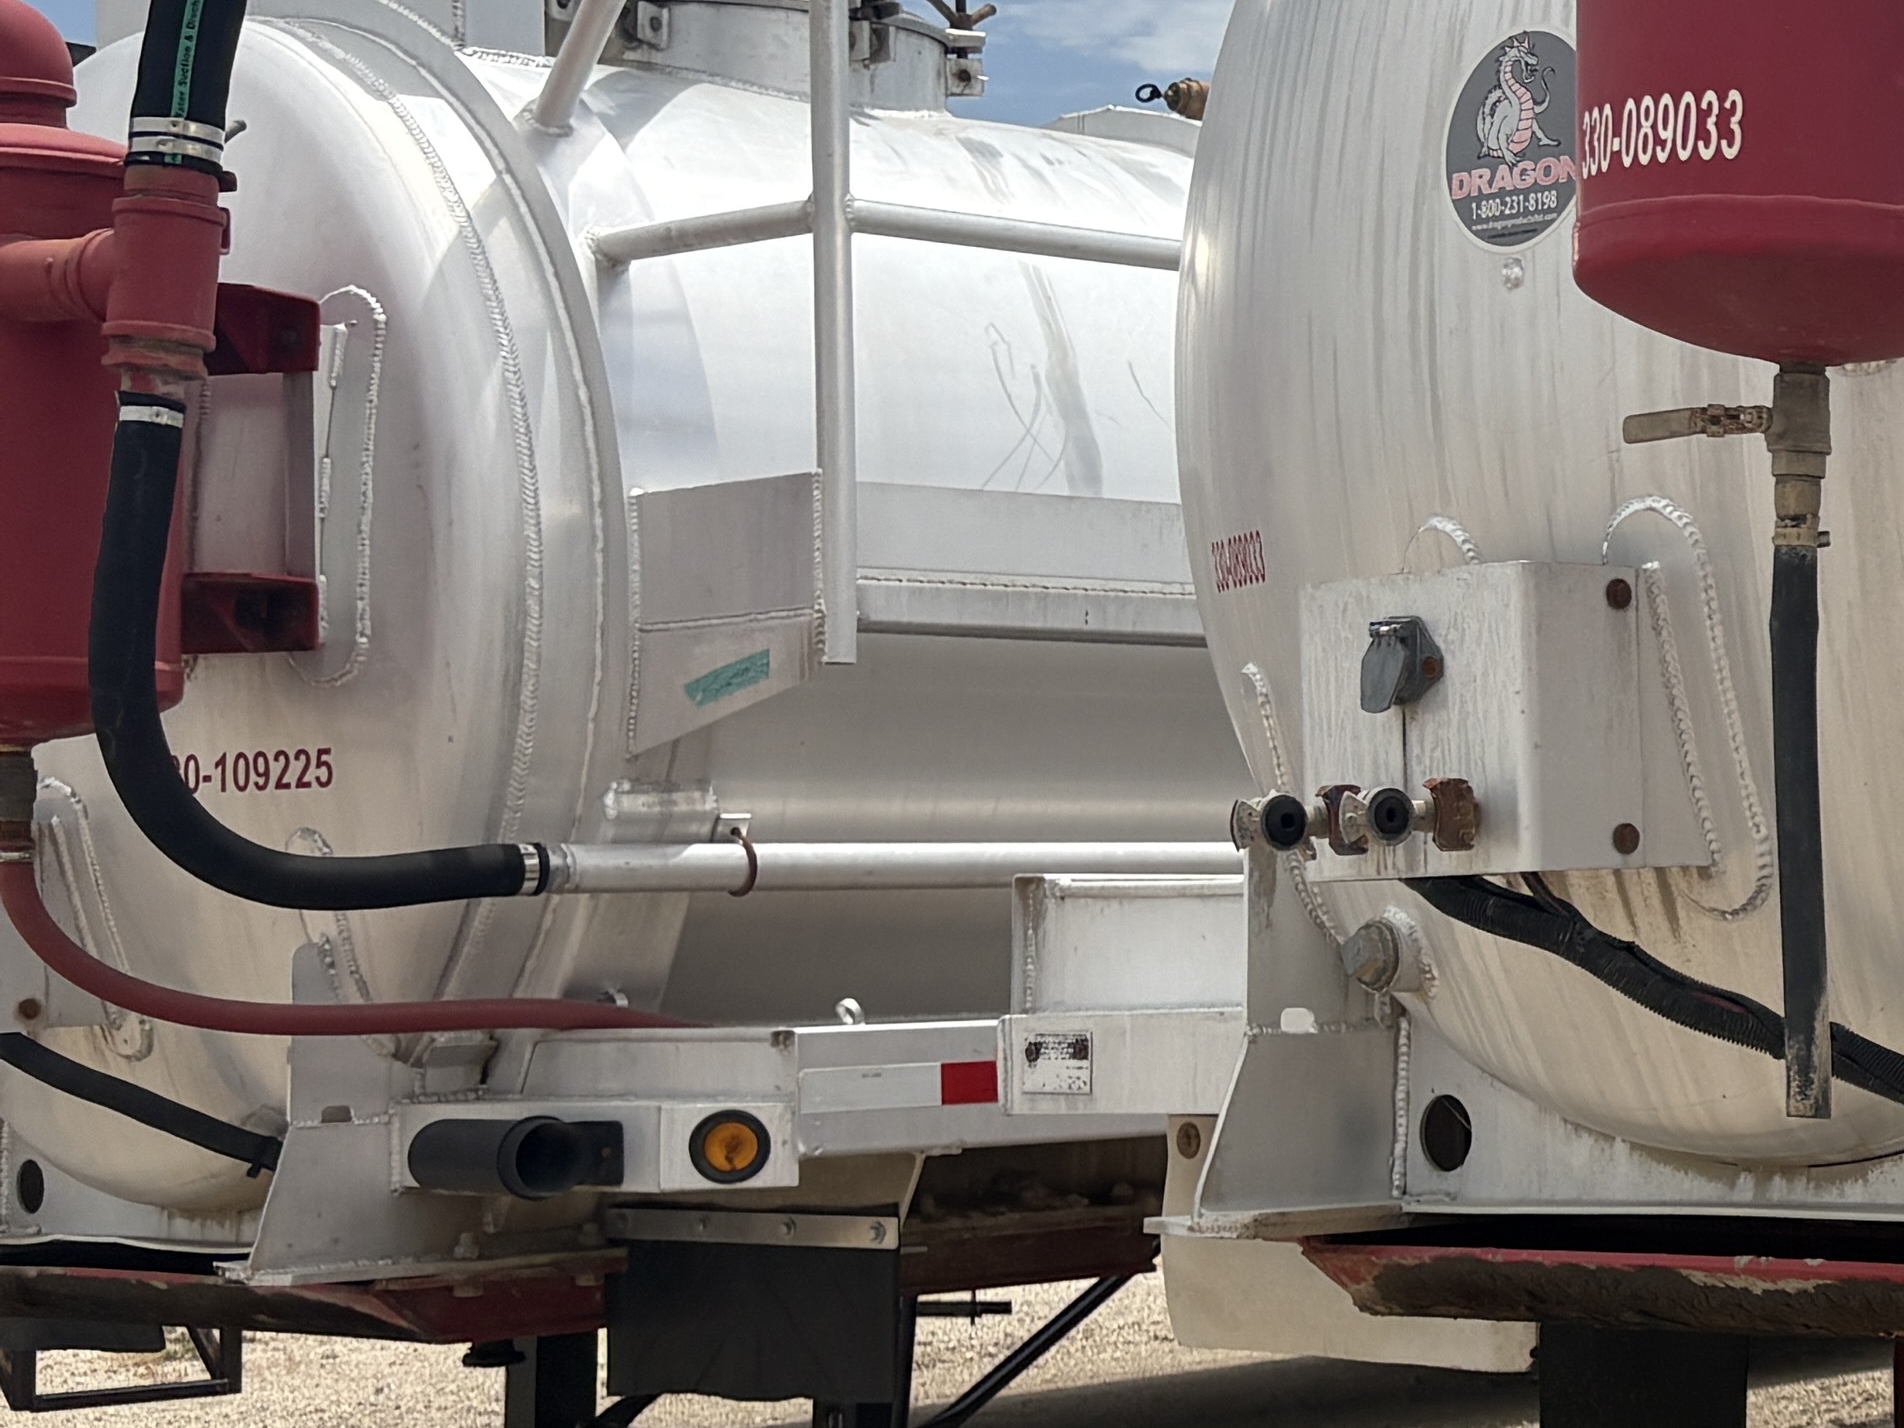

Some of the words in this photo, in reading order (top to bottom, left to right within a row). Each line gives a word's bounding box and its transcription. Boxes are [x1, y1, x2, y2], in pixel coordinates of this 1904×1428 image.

[1582, 89, 1743, 180] 330-089033
[1452, 155, 1576, 200] DRAGON
[1472, 190, 1557, 220] 1-800-231-8198
[172, 747, 334, 795] 0-109225
